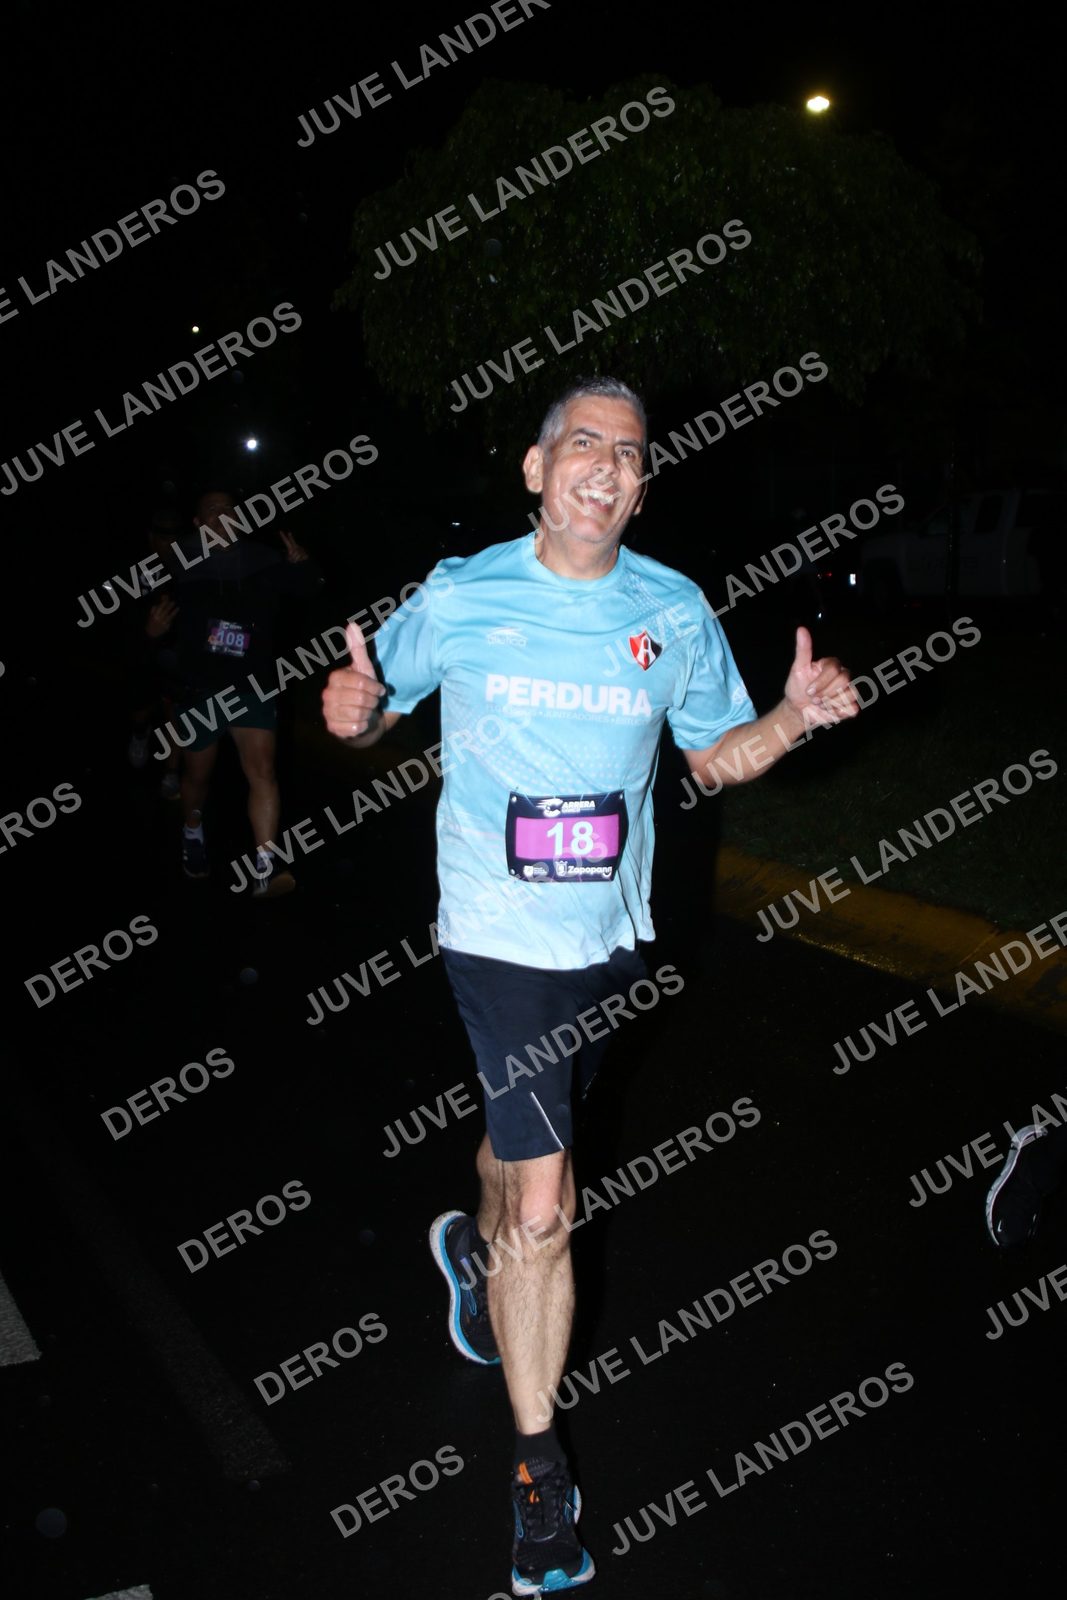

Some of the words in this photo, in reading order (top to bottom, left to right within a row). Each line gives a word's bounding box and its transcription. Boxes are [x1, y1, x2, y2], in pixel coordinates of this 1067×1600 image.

[216, 630, 245, 647] 108
[485, 674, 652, 717] PERDURA
[547, 821, 593, 856] 18
